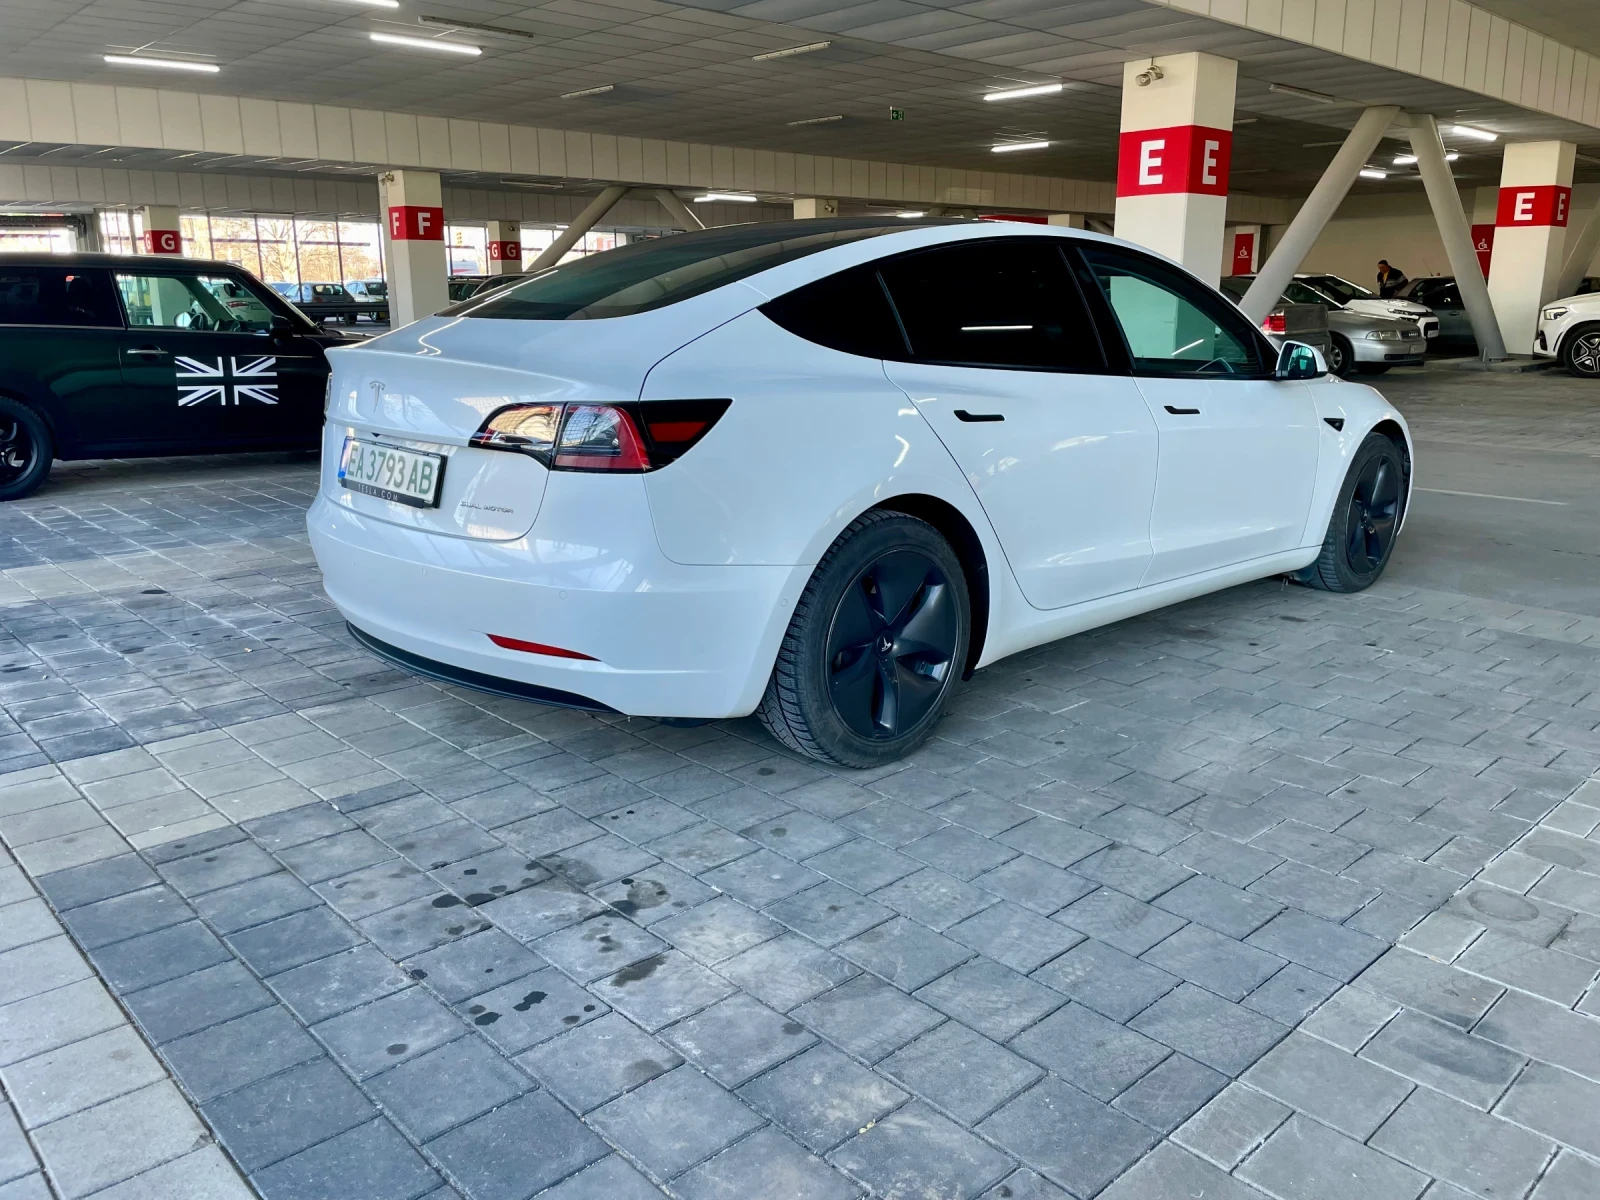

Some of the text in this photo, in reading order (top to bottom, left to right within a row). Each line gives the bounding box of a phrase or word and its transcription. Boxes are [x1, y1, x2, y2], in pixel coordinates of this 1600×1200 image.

[1139, 139, 1165, 186] E
[1202, 139, 1219, 185] E
[1514, 192, 1536, 221] E
[1557, 193, 1566, 220] E
[392, 212, 400, 235] F
[417, 212, 431, 235] F
[145, 233, 151, 250] G
[161, 234, 175, 250] G
[491, 243, 498, 258] G
[506, 244, 516, 258] G
[347, 443, 433, 494] EA 3793 AB
[358, 483, 398, 501] TESLA.COM
